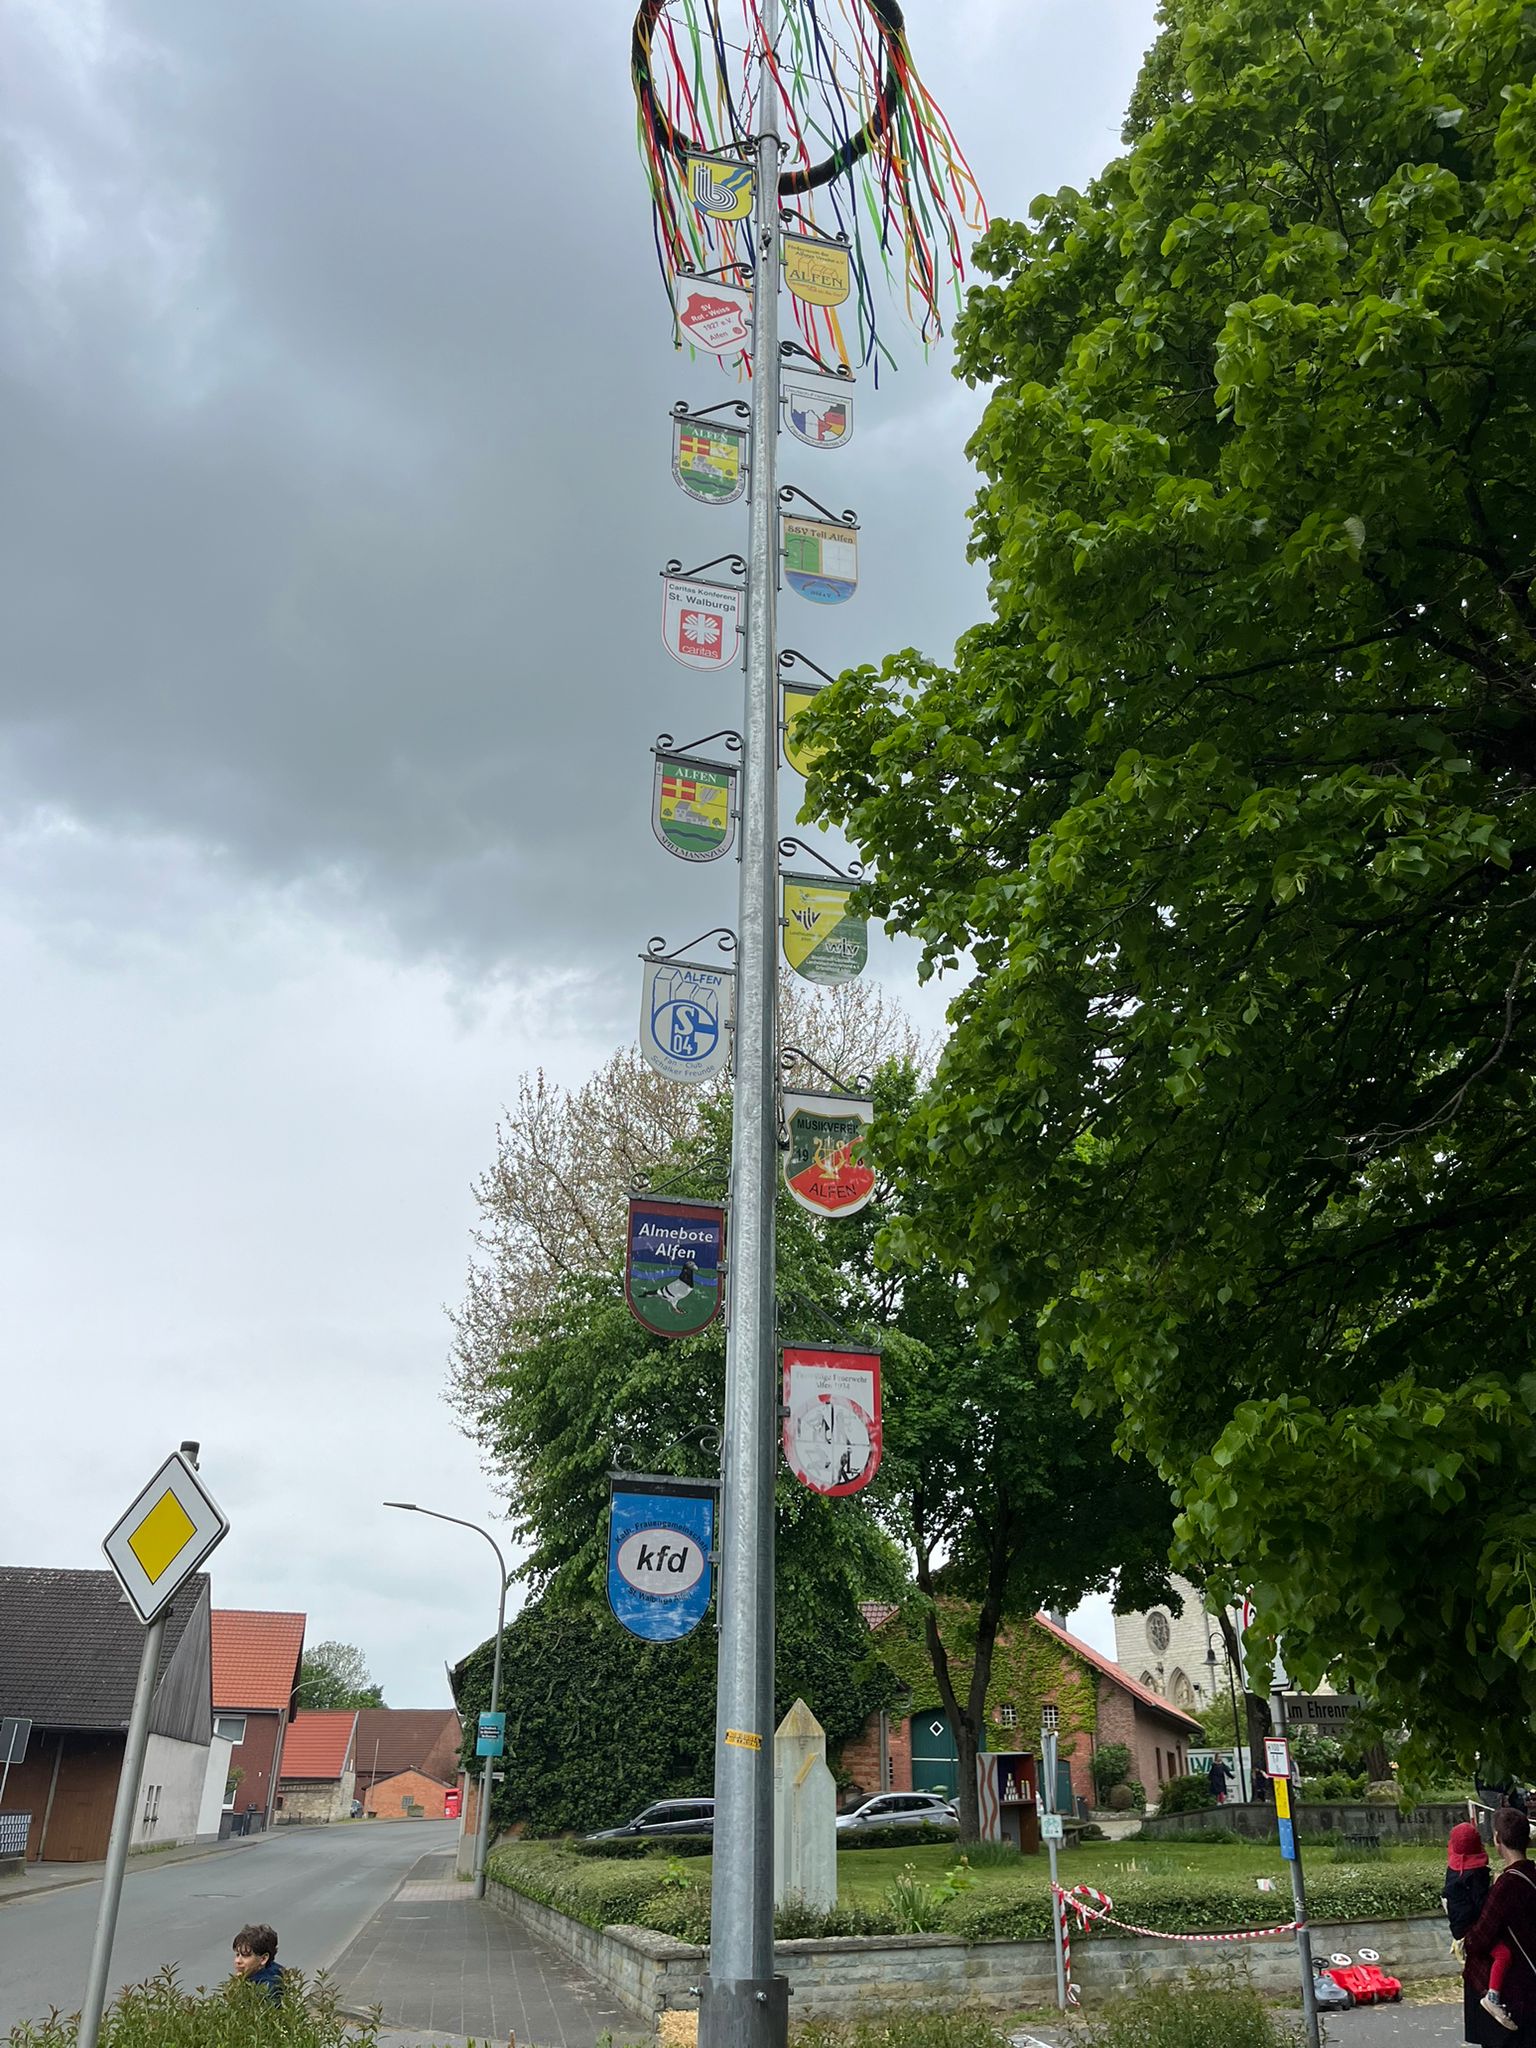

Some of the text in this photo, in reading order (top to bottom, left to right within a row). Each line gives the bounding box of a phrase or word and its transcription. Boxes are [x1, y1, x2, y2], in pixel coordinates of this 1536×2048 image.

[790, 270, 843, 288] ALFEN
[700, 303, 712, 312] SV
[708, 306, 731, 317] Weiss
[709, 332, 729, 341] Alfen
[788, 525, 854, 544] SSV Tell Alfen
[669, 583, 736, 601] Caritas Konferenz
[668, 592, 736, 612] St. Walburga
[682, 645, 718, 659] caritas
[675, 767, 718, 784] ALFEN
[661, 836, 726, 860] SPIELMANNSZUG
[684, 971, 722, 986] ALFEN
[673, 1034, 693, 1055] 04
[651, 1055, 716, 1077] Schalker Freunde
[797, 1118, 859, 1135] MUSIKVEREI
[809, 1182, 857, 1199] ALFEN
[639, 1222, 714, 1243] Almebote
[655, 1242, 696, 1261] Alfen
[833, 1374, 868, 1384] Fuerwehr
[635, 1520, 709, 1552] Frauengemeinschaft
[636, 1544, 688, 1574] kfd
[638, 1593, 673, 1605] Walbrga
[1307, 1701, 1360, 1719] Ehrenm
